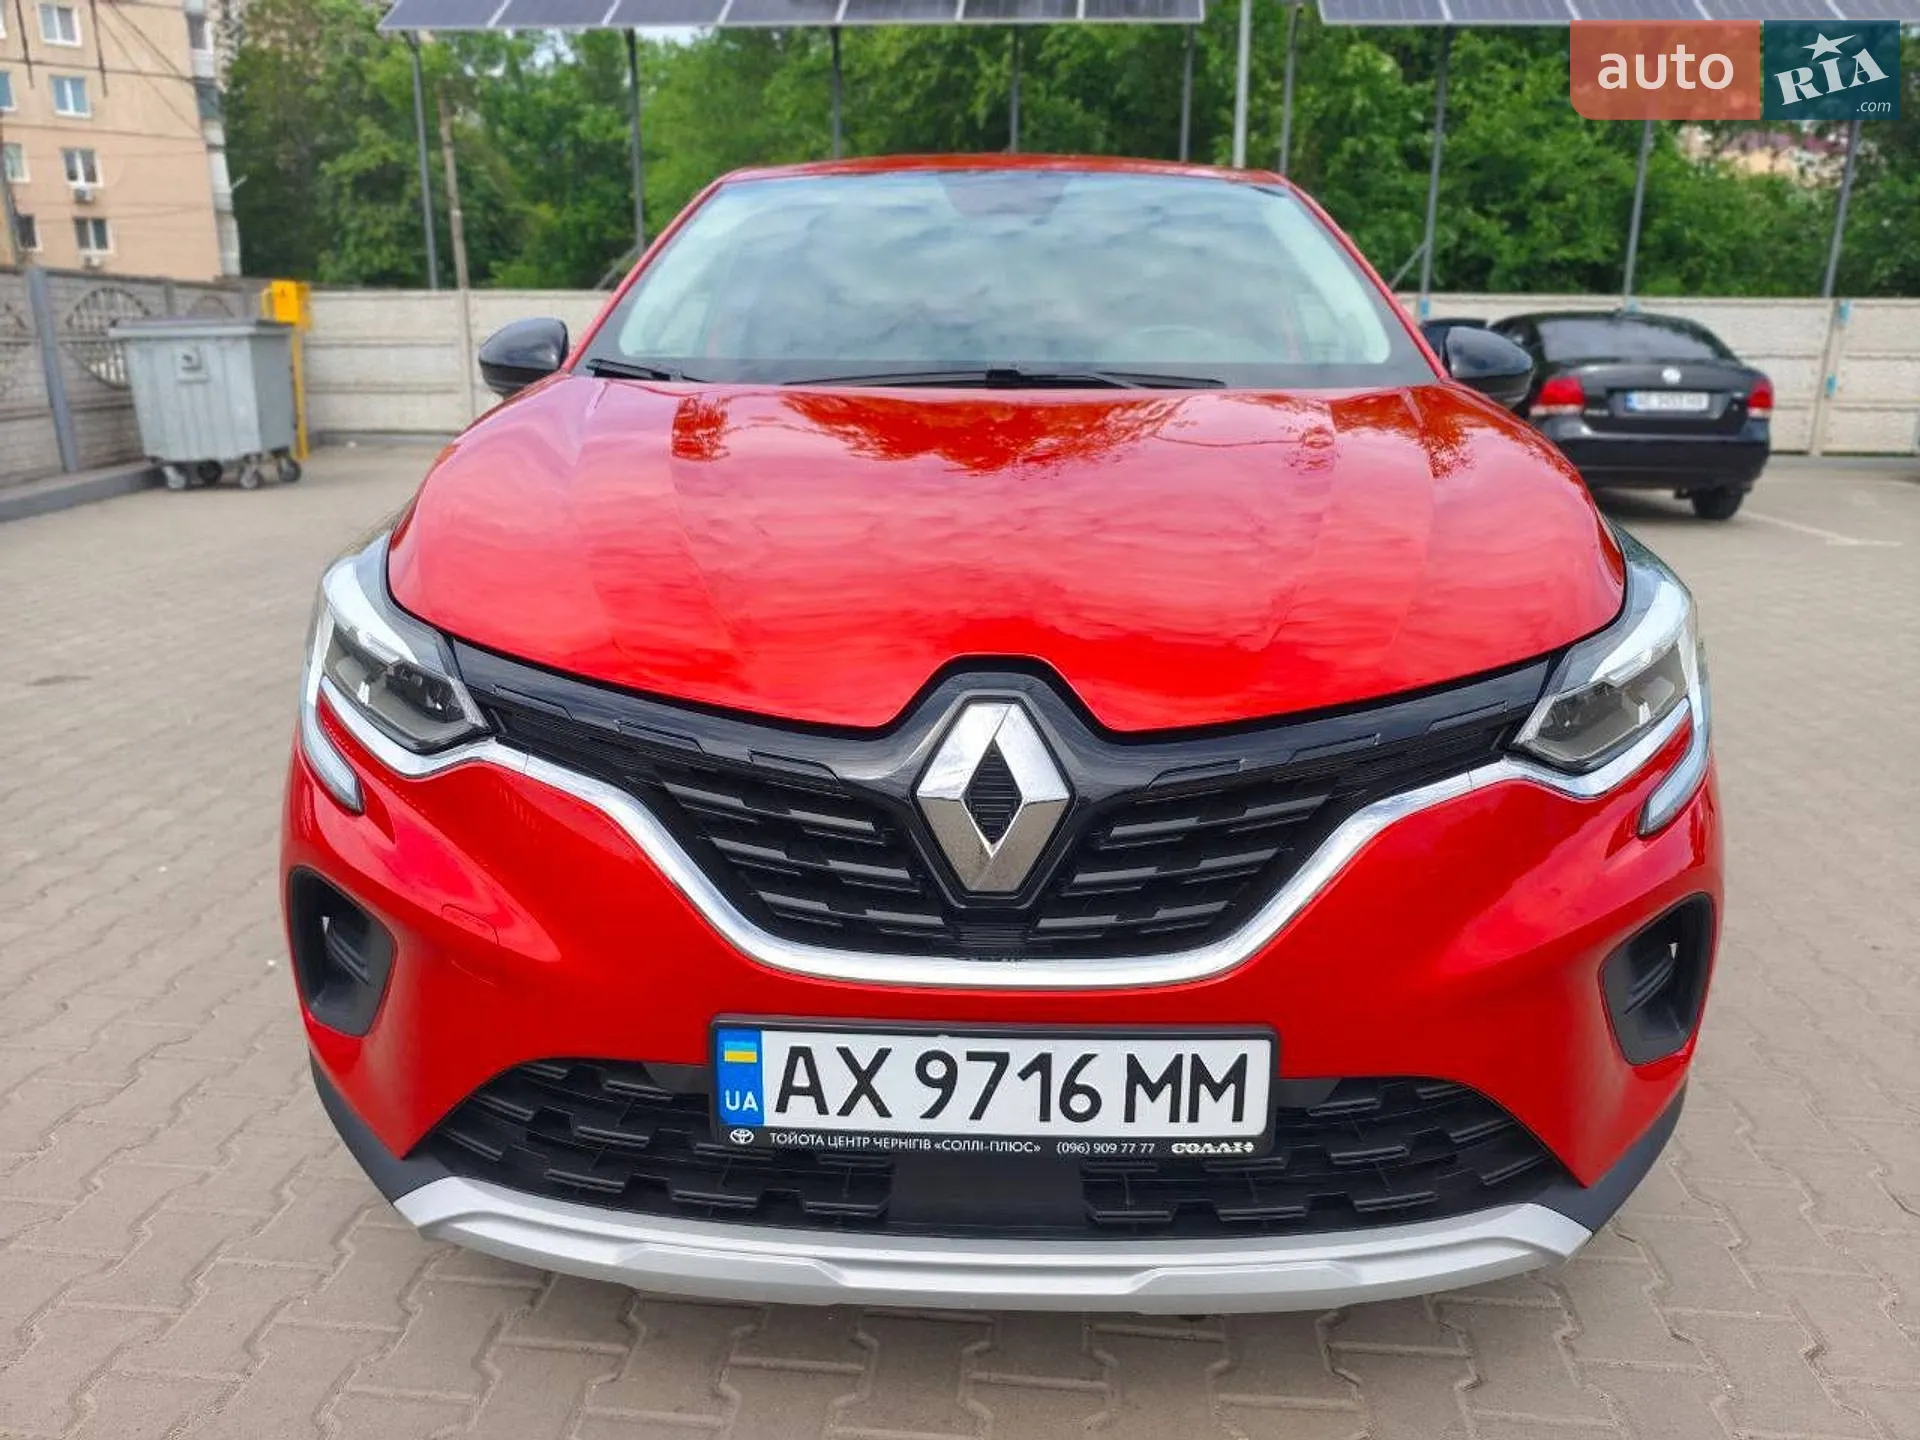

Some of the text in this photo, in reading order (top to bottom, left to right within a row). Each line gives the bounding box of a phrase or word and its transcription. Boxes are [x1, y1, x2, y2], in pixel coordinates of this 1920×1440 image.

[774, 1045, 1248, 1124] AX 9716 MM
[725, 1090, 758, 1112] UA
[769, 1131, 825, 1147] ТОЙОТА
[828, 1134, 871, 1149] ЦЕНТР
[873, 1136, 932, 1150] ЧЕРНІГІВ
[1056, 1141, 1091, 1154] (096)
[1093, 1142, 1117, 1153] 909
[1120, 1142, 1136, 1153] 77
[1138, 1142, 1155, 1153] 77
